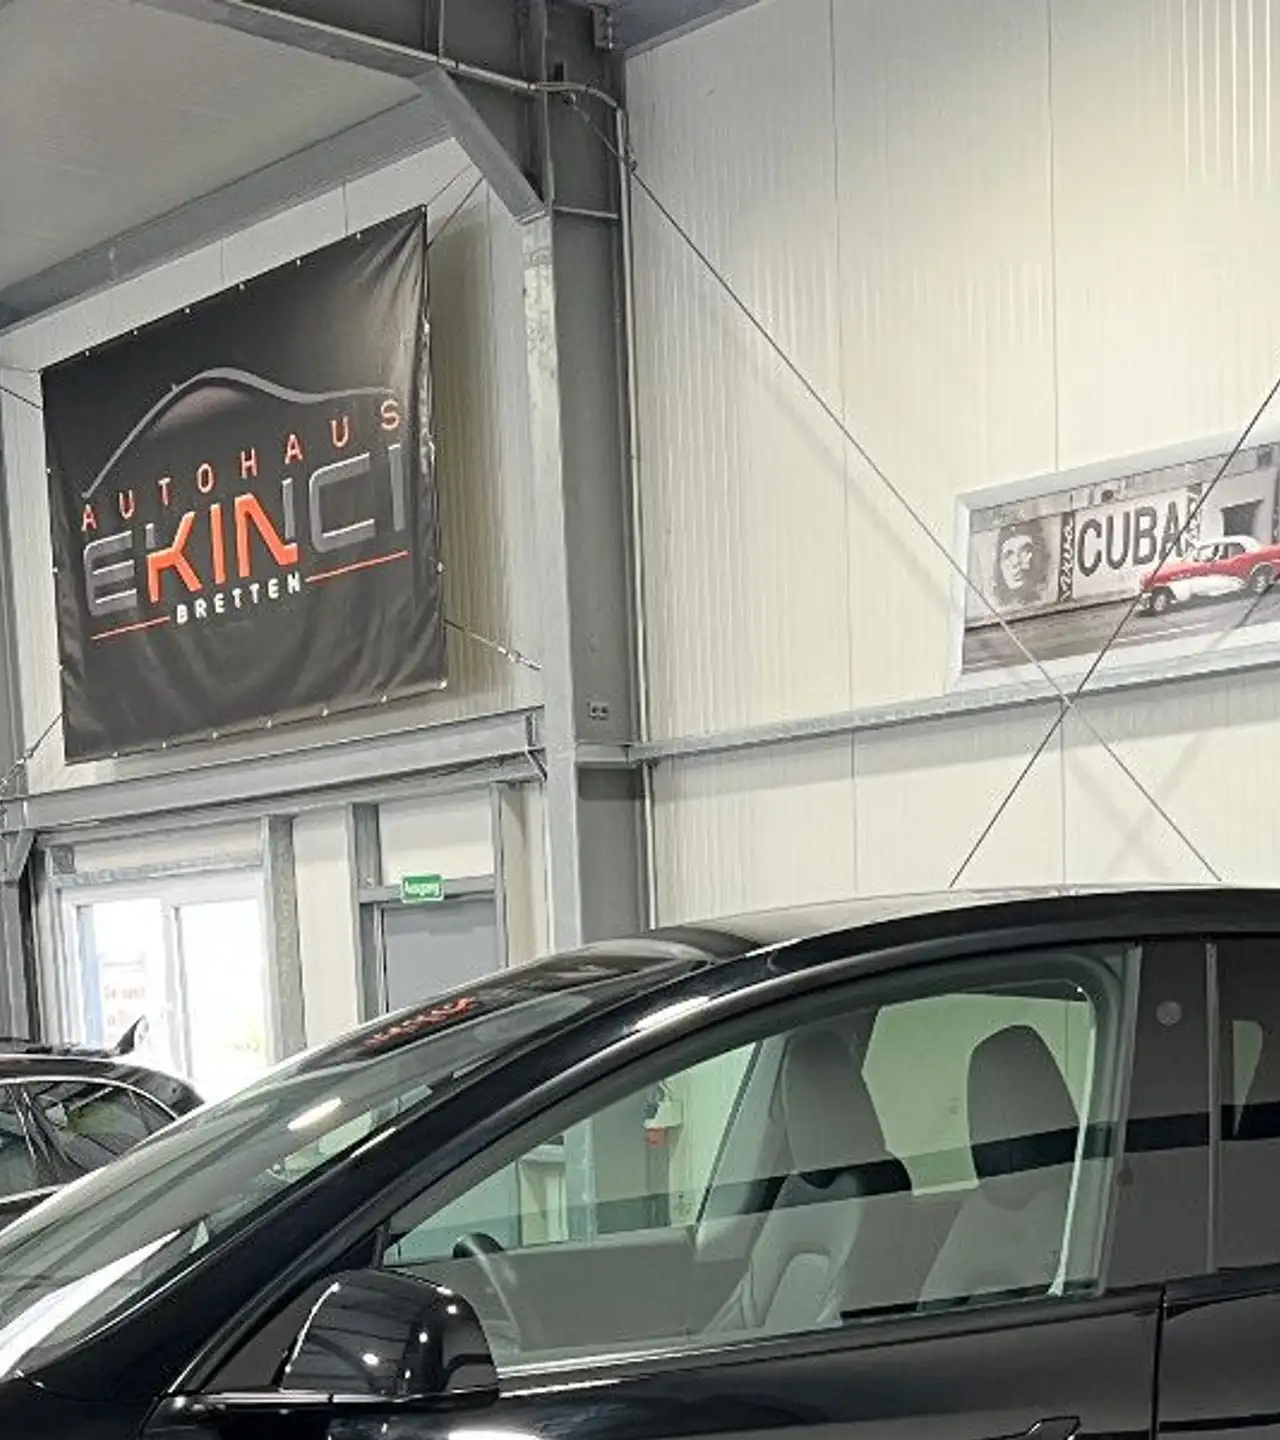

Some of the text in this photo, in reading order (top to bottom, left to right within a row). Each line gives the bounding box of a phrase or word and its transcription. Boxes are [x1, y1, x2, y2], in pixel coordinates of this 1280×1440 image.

[81, 399, 400, 531] AUTOHAUS
[1077, 501, 1184, 578] CUBA
[175, 571, 302, 625] BRETTEN
